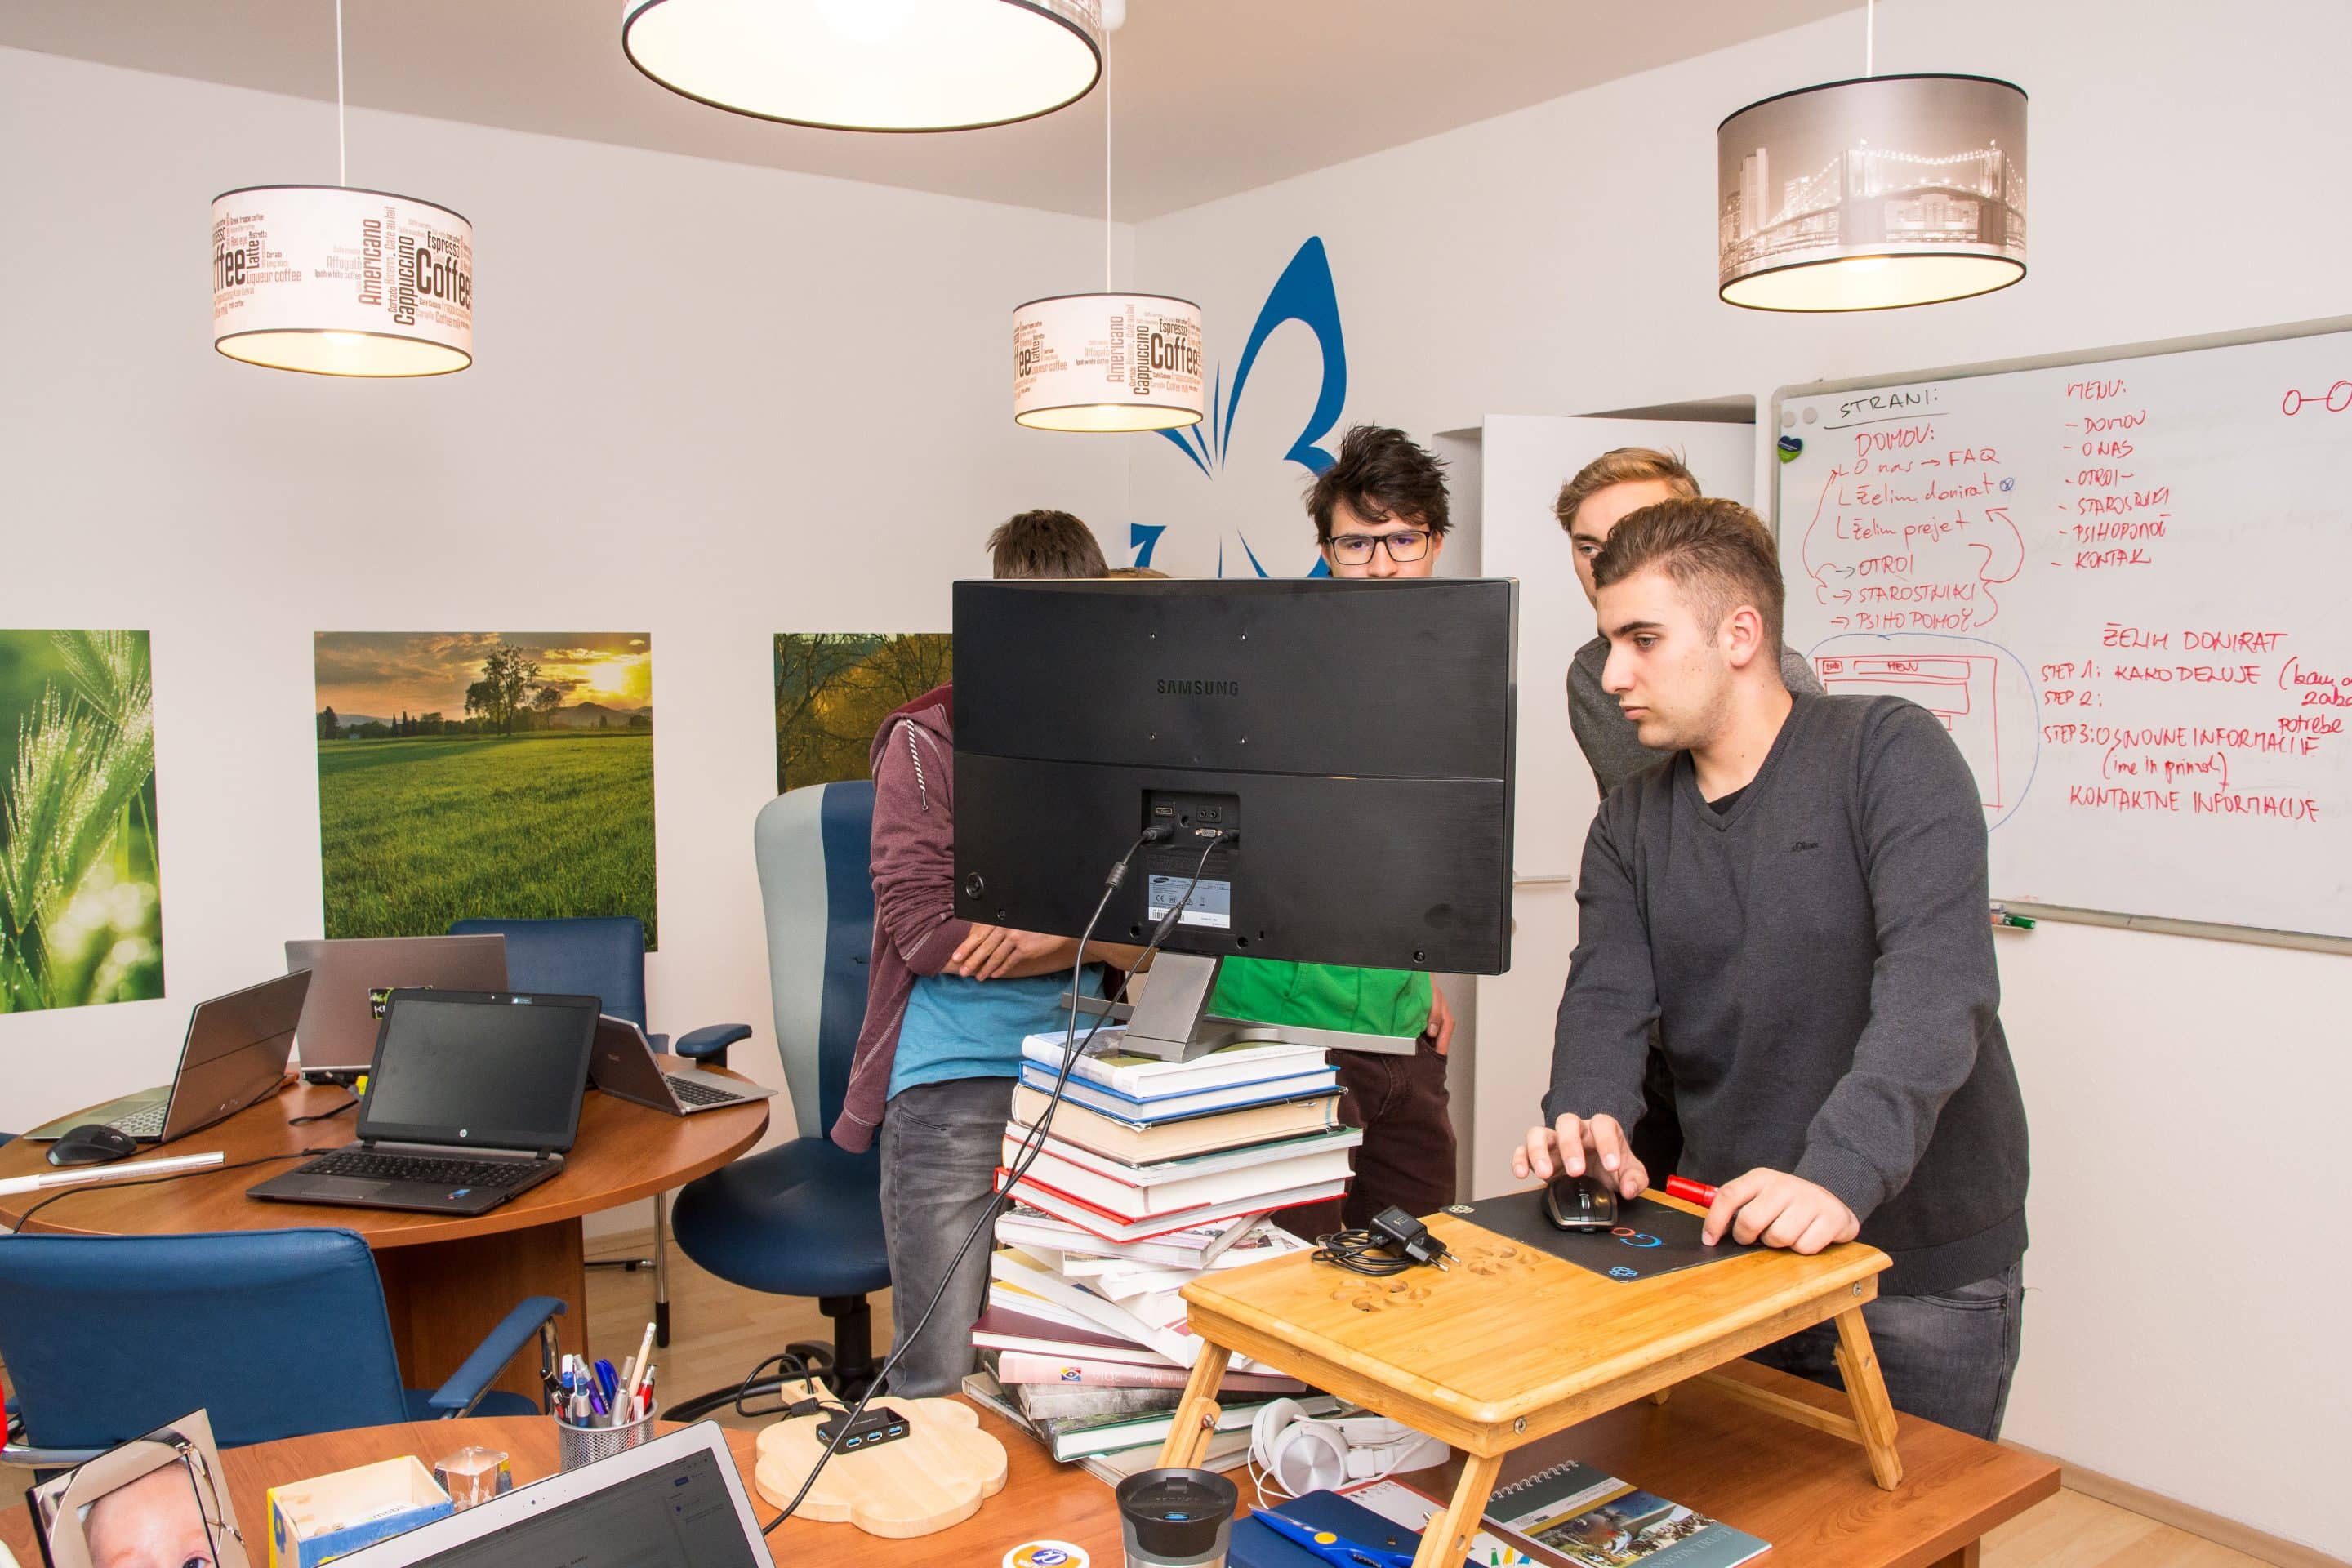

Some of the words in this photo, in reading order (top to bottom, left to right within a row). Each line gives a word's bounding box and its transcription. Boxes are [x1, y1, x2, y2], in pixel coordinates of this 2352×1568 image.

[246, 239, 260, 270] Latte
[427, 230, 460, 258] Espresso
[274, 269, 301, 282] coffee
[359, 219, 381, 305] Americano
[394, 235, 419, 326] Cappuccino
[416, 247, 470, 310] Coffee
[1160, 318, 1187, 336] Espresso
[1107, 316, 1125, 382] Americano
[1134, 325, 1152, 396] Cappuccino
[1151, 333, 1198, 376] Coffee
[1840, 388, 1938, 419] STRANI:
[1949, 448, 2000, 466] FAQ
[2183, 630, 2289, 653] DONIRAT
[2042, 662, 2075, 682] STEP
[2115, 665, 2172, 683] KAKO
[2176, 665, 2261, 684] DELUJE
[1156, 679, 1240, 696] SAMSUNG
[2044, 689, 2074, 706] STEP
[2070, 785, 2180, 813] KONTAKTNE
